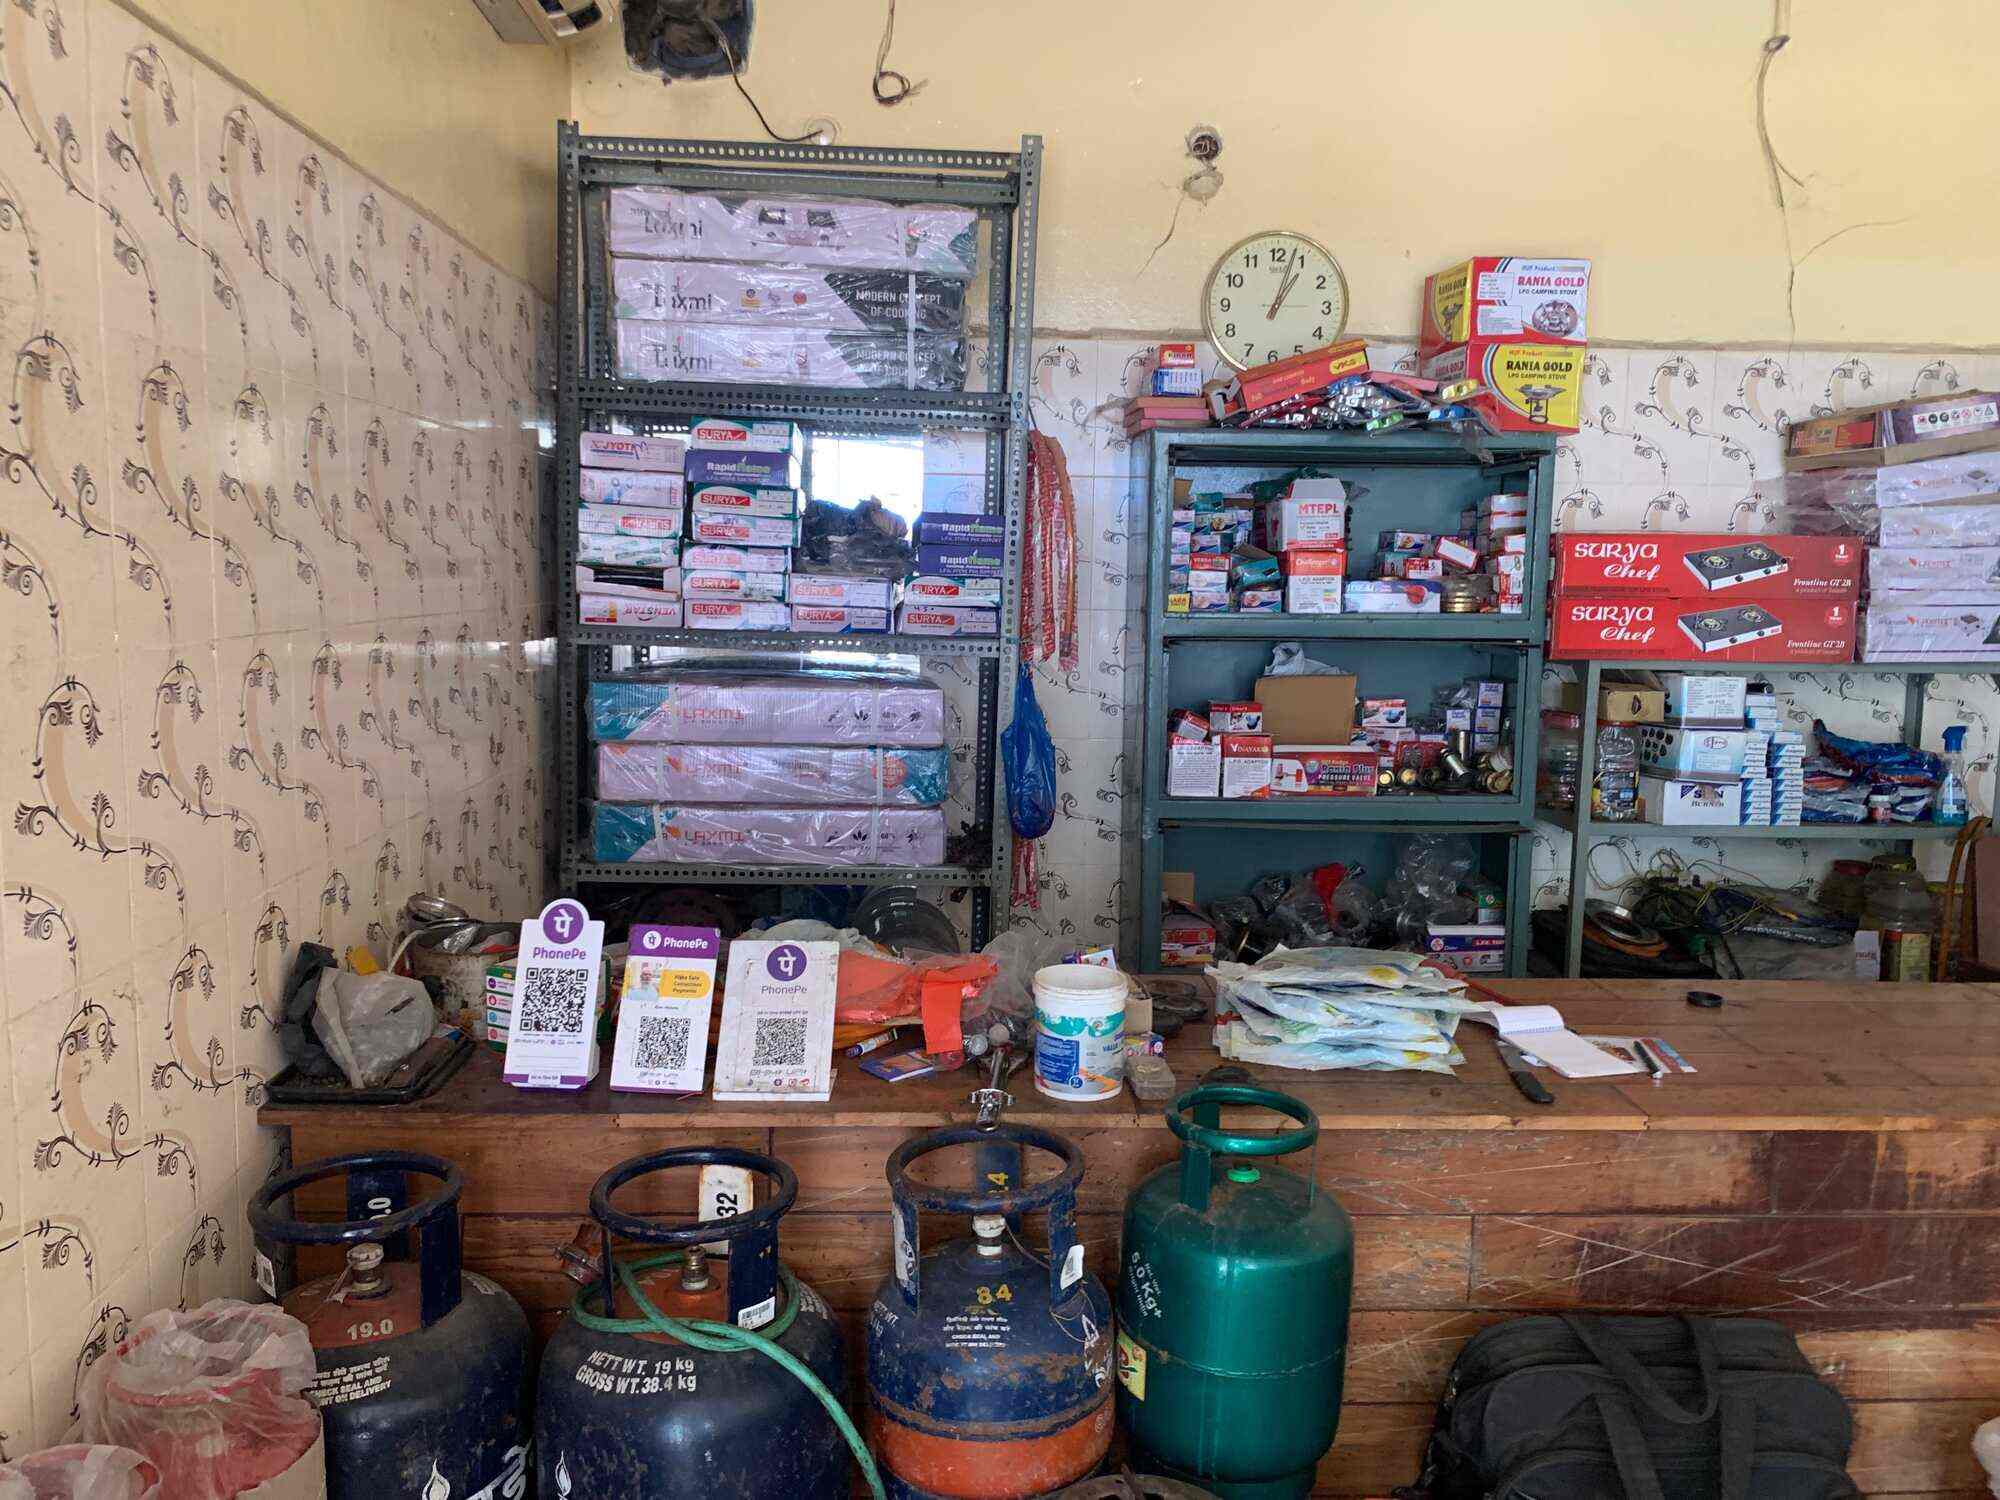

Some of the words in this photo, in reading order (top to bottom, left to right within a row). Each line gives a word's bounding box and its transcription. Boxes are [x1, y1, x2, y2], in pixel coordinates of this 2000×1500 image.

[1243, 254, 1258, 268] 11
[1270, 248, 1286, 262] 12
[1298, 255, 1305, 268] 1
[1225, 273, 1244, 288] 10
[1316, 275, 1326, 289] 2
[1517, 276, 1551, 287] RANIA
[1554, 276, 1585, 287] GOLD
[856, 290, 896, 302] MODERN
[871, 307, 882, 316] OF
[1220, 298, 1231, 312] 9
[1321, 301, 1332, 315] 3
[1225, 323, 1236, 337] 8
[1312, 326, 1323, 340] 4
[1244, 343, 1254, 357] 7
[1267, 350, 1278, 363] 6
[1506, 361, 1541, 371] RANIA
[1543, 362, 1573, 372] GOLD
[698, 429, 734, 441] SURYA
[702, 494, 737, 505] SURYA
[701, 525, 736, 537] SURYA
[1838, 543, 1845, 555] 1
[1603, 563, 1660, 582] Chef
[692, 578, 727, 589] SURYA
[1793, 578, 1828, 587] Frontline
[797, 586, 832, 596] SURYA
[914, 585, 947, 596] SURYA
[694, 604, 729, 615] SURYA
[797, 611, 832, 621] SURYA
[1832, 606, 1840, 617] 1
[910, 614, 942, 625] SURYA
[1600, 625, 1656, 643] Chef
[1786, 640, 1821, 649] Frontline
[1693, 790, 1724, 798] SN
[663, 938, 709, 949] PhonePe
[532, 947, 587, 960] PhonePe
[761, 985, 808, 995] PhonePe
[716, 1192, 738, 1217] 32
[976, 1284, 1012, 1305] 84
[346, 1318, 393, 1341] 19.0
[587, 1350, 624, 1371] NETT
[622, 1358, 648, 1375] WT.
[654, 1360, 672, 1375] 19
[675, 1357, 694, 1373] kg
[340, 1381, 363, 1394] SEAL
[363, 1375, 382, 1388] AND
[575, 1364, 615, 1392] GROSS
[678, 1374, 697, 1392] kg
[349, 1379, 392, 1400] DELIVERY
